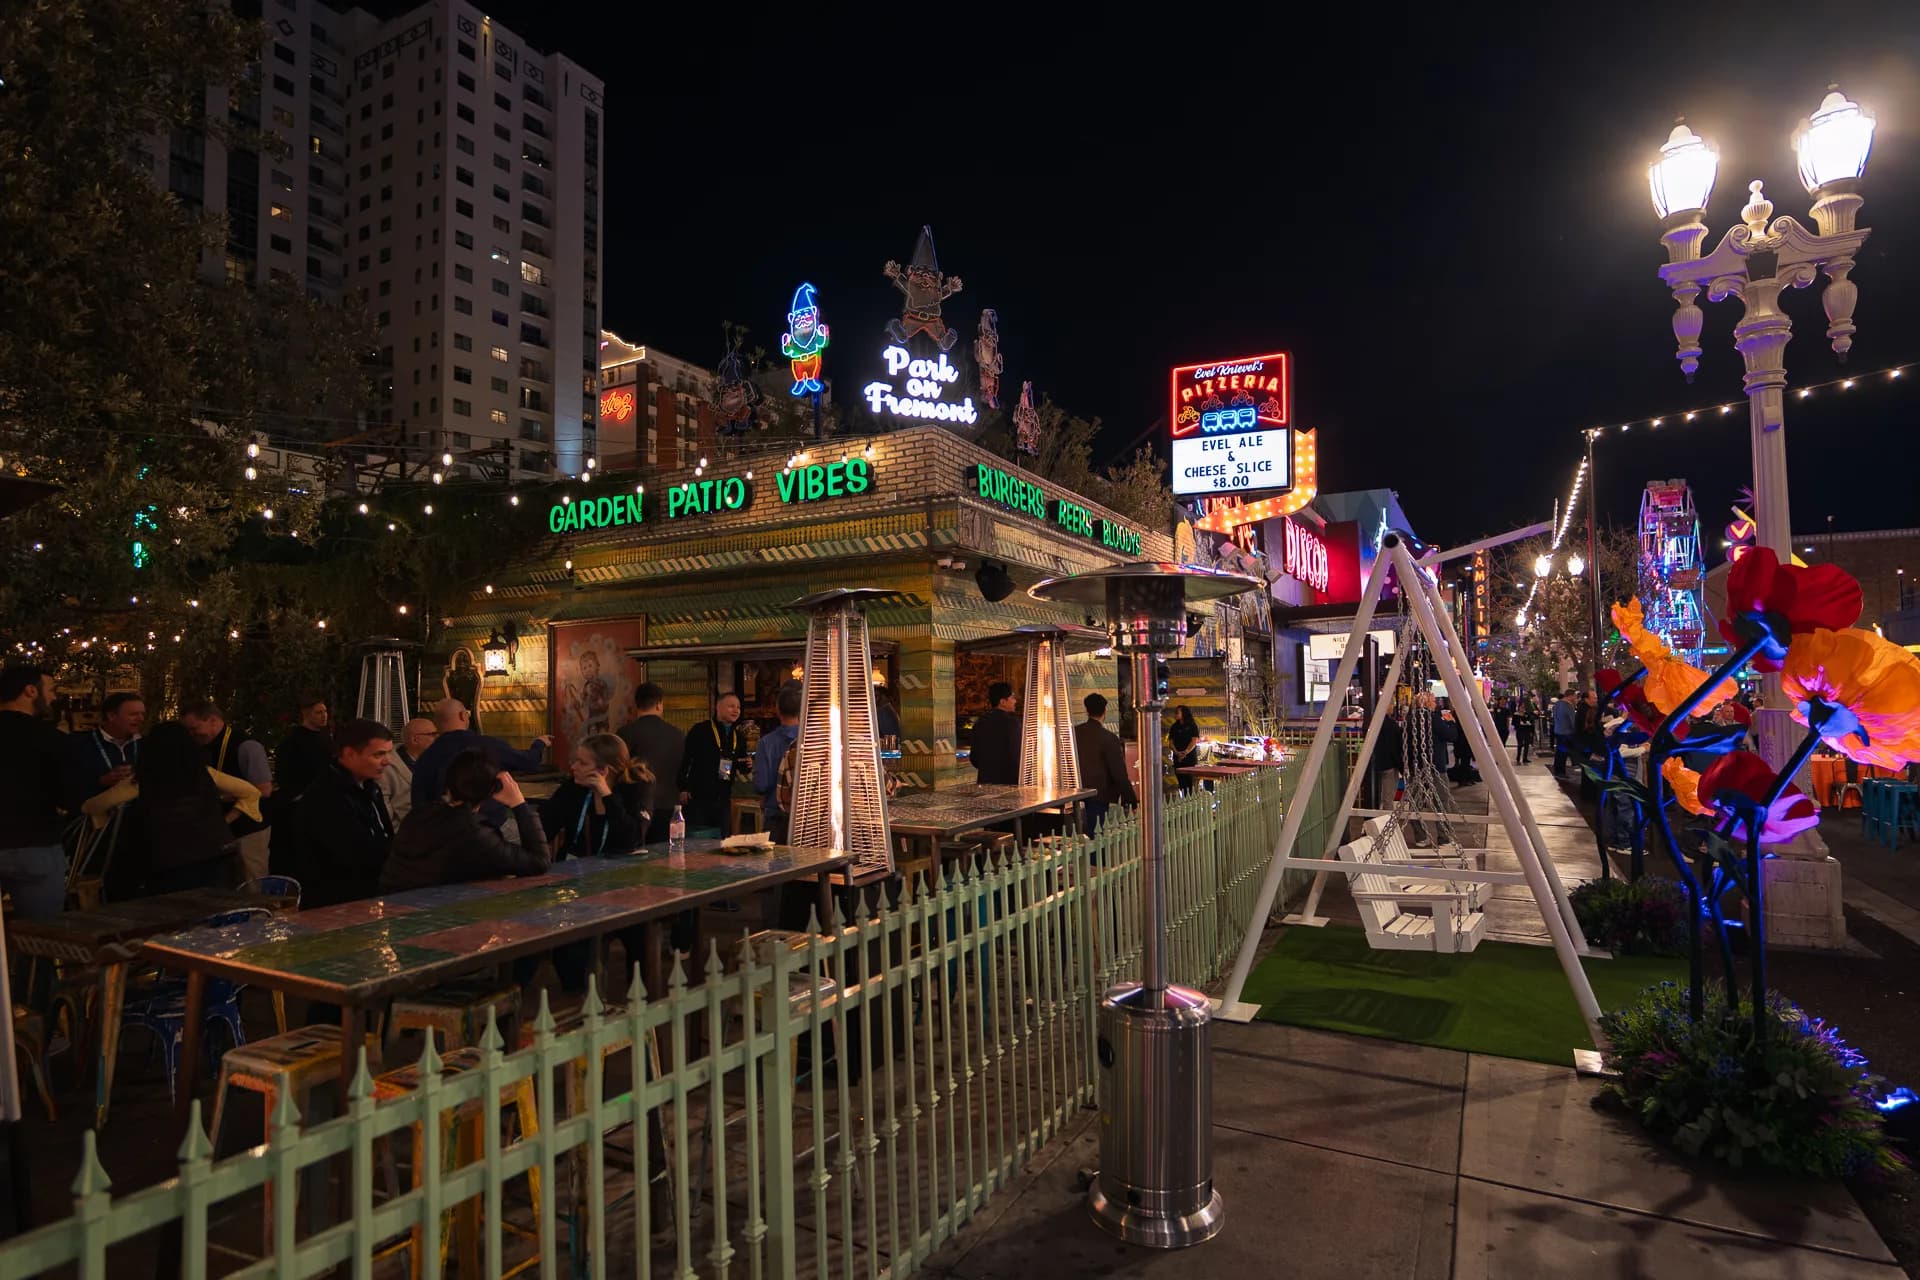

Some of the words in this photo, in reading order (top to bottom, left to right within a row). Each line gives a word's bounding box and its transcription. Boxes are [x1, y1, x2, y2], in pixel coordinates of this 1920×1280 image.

[883, 345, 959, 383] Park
[1194, 368, 1216, 379] Evel
[1216, 360, 1264, 375] Knievel's
[906, 379, 942, 399] on
[1181, 374, 1279, 402] PIZZERIA
[863, 382, 978, 424] Fremont
[1202, 438, 1231, 451] EVEL
[1239, 435, 1264, 448] ALE
[1227, 451, 1236, 462] &
[1184, 464, 1227, 478] CHEESE
[1237, 460, 1272, 474] SLICE
[1213, 475, 1249, 488] $8.00
[550, 493, 643, 533] GARDEN
[668, 477, 745, 518] PATIO
[775, 459, 868, 503] VIBES
[978, 463, 1046, 519] BURGERS
[1058, 499, 1093, 538] BEERS
[1102, 519, 1142, 556] BLOODYS
